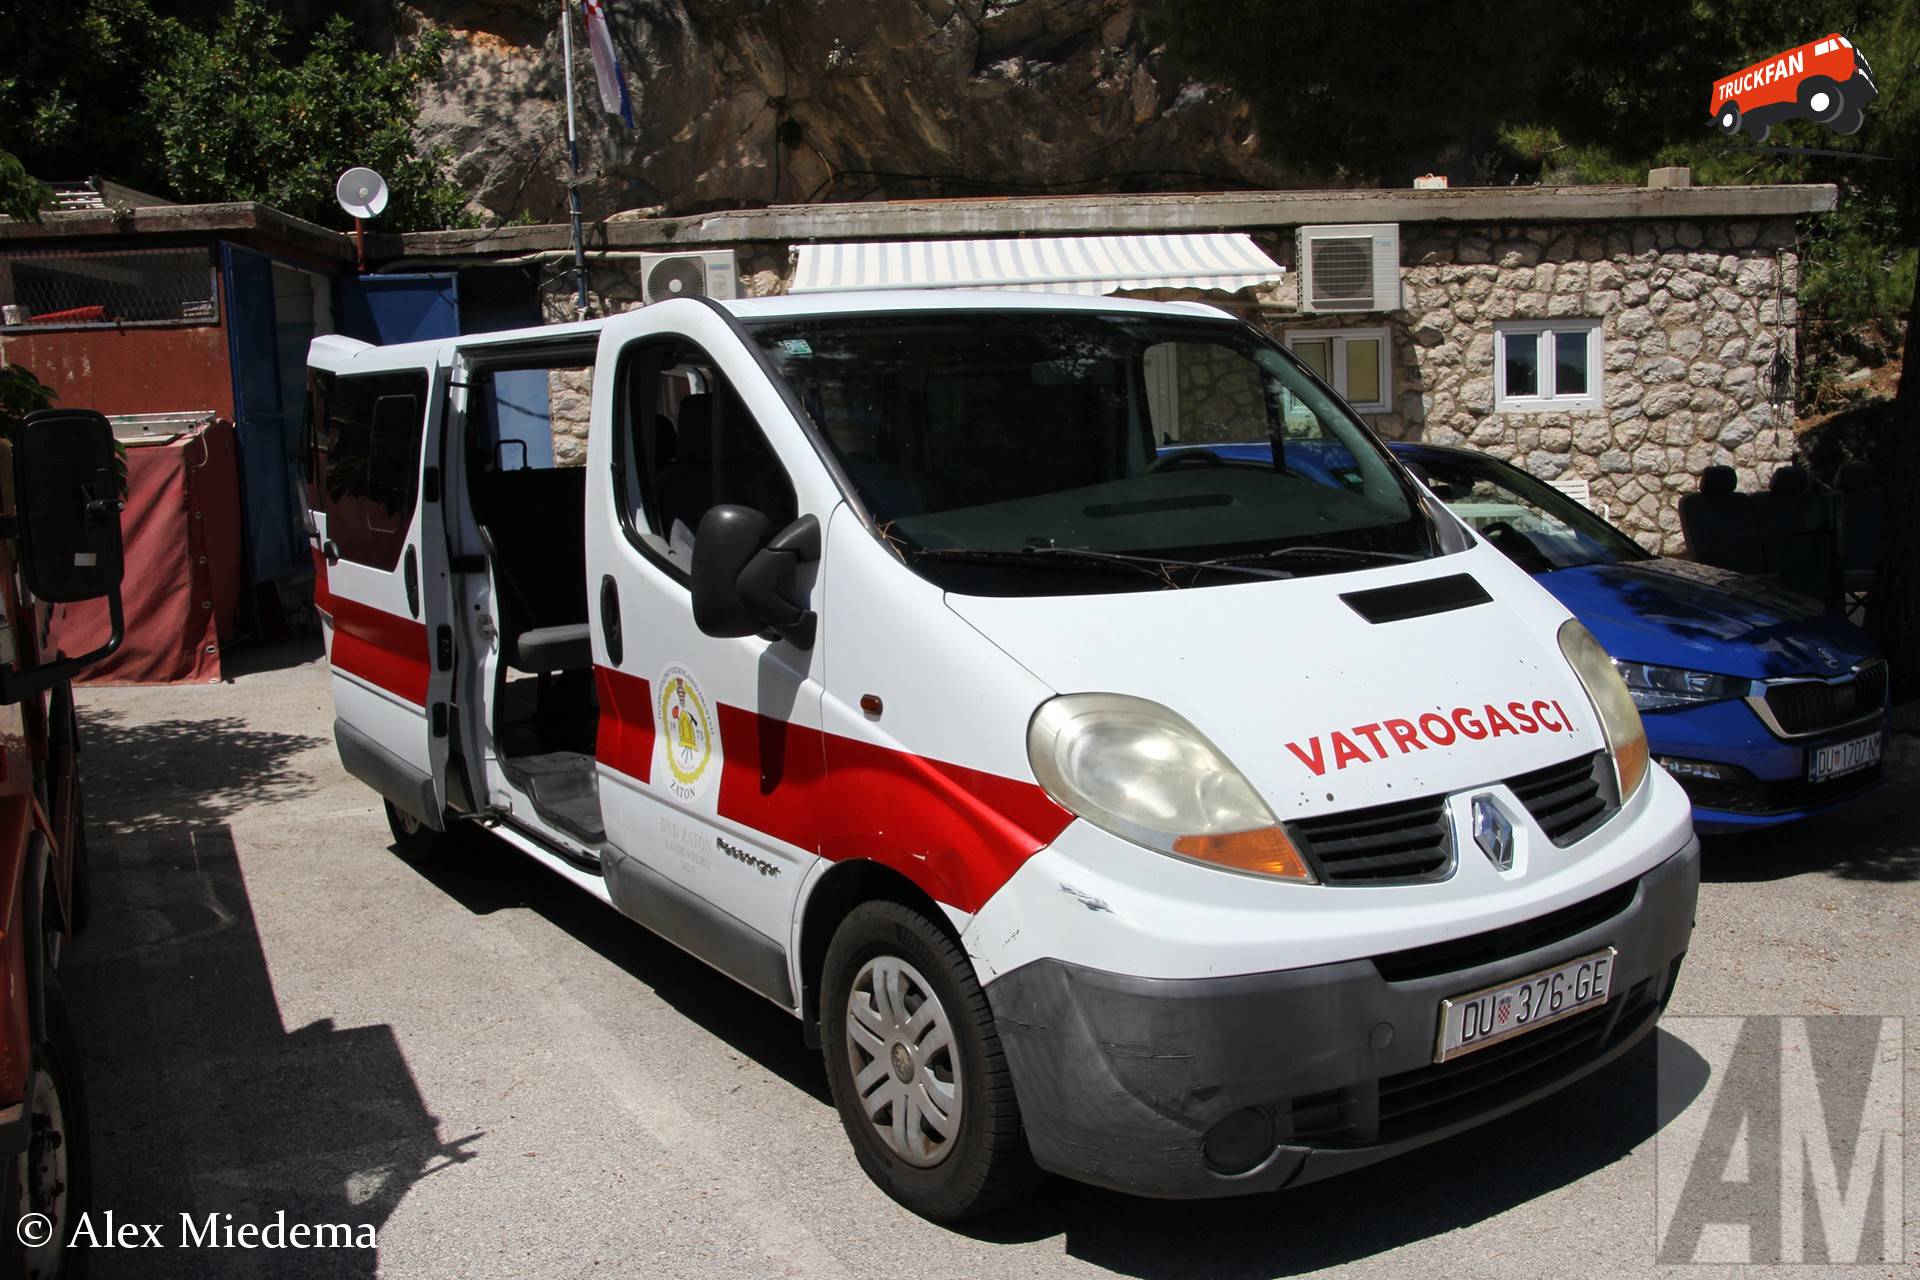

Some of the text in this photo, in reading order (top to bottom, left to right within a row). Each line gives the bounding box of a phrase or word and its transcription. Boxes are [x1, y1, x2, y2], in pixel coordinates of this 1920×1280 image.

[1284, 700, 1574, 777] VATROGASCI
[1818, 750, 1834, 774] DU
[670, 779, 696, 800] ZATON
[717, 837, 781, 877] Passenger
[1460, 995, 1496, 1043] DU
